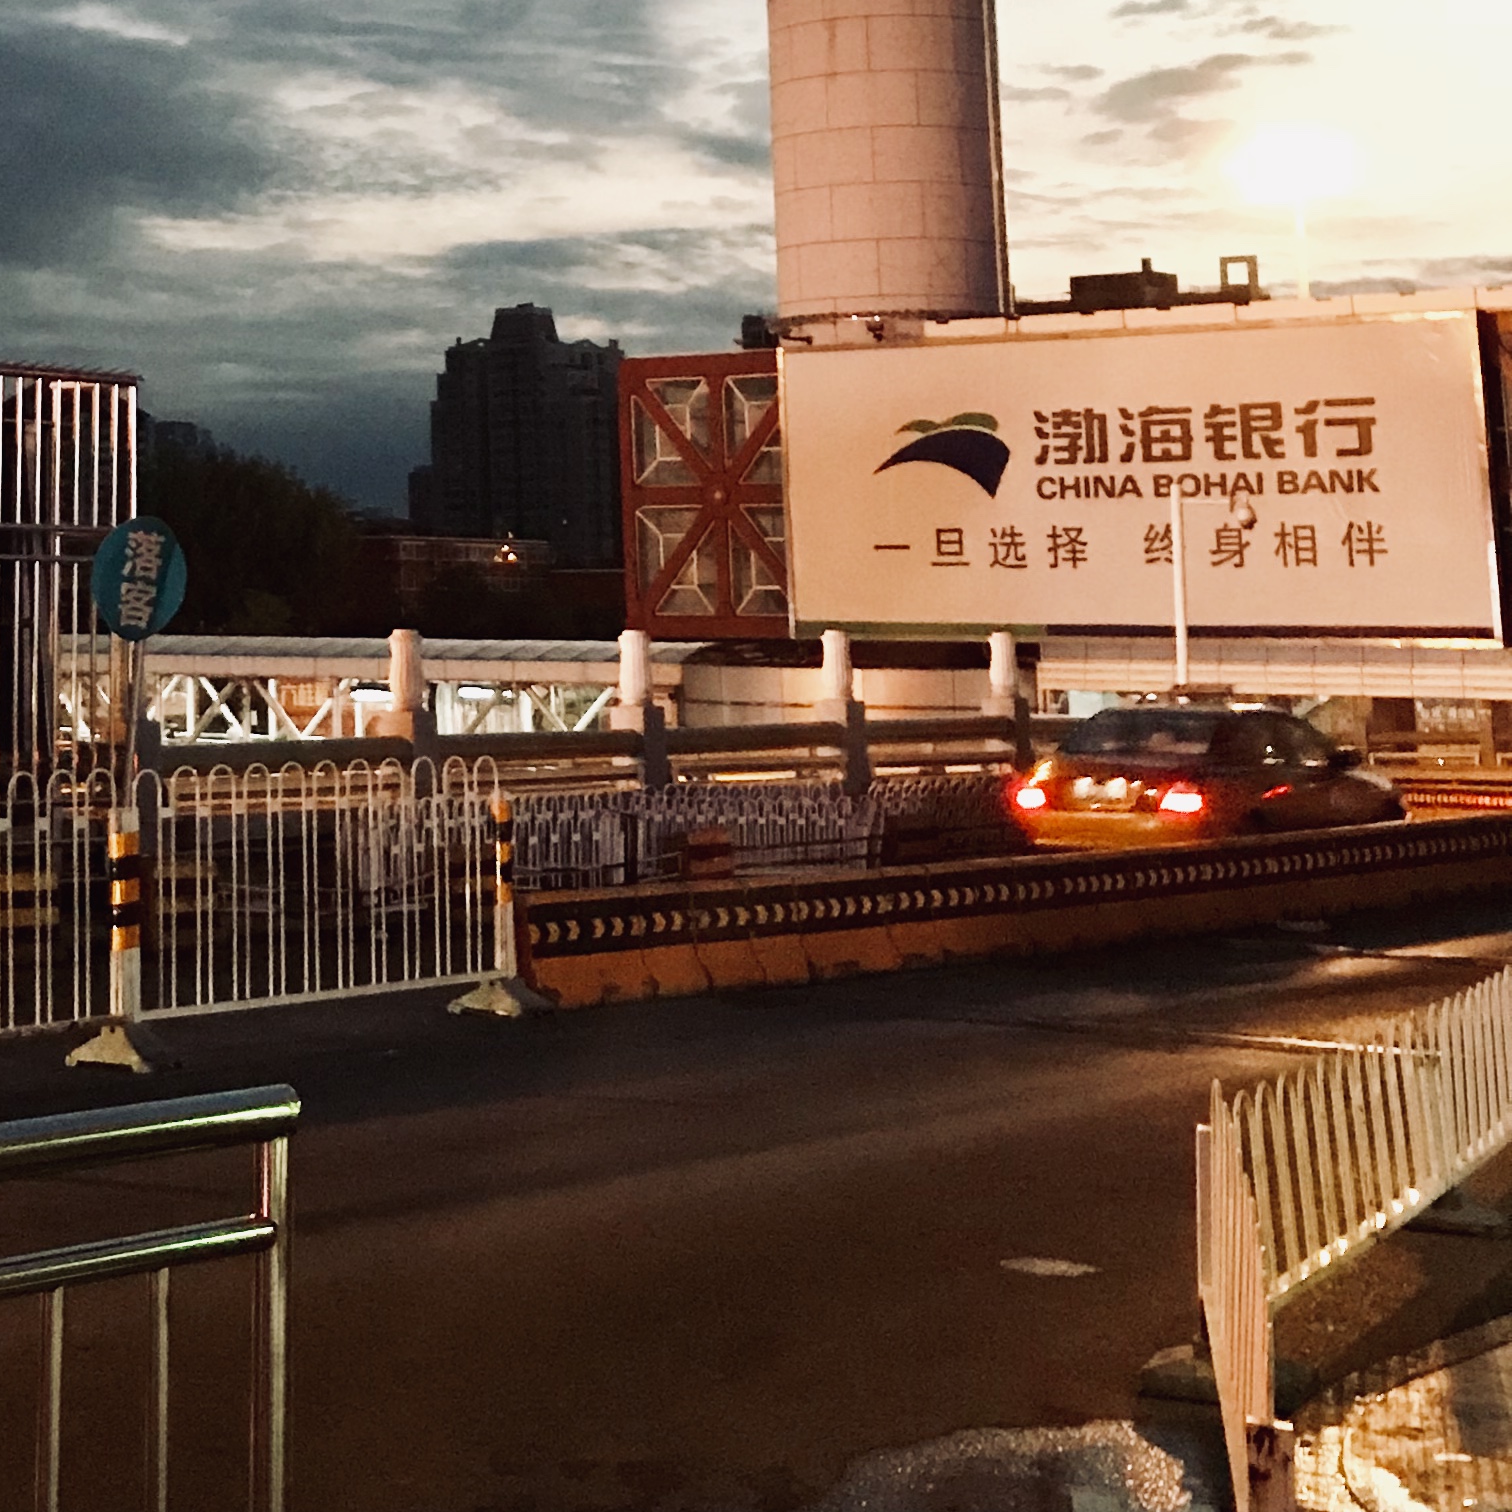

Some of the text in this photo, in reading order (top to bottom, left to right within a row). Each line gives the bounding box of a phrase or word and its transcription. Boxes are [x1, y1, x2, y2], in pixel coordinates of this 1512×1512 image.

[1033, 397, 1377, 466] 渤海银行
[1037, 468, 1381, 501] CHINA BOHAI BANK
[874, 520, 1389, 569] 一旦选择 终身相伴
